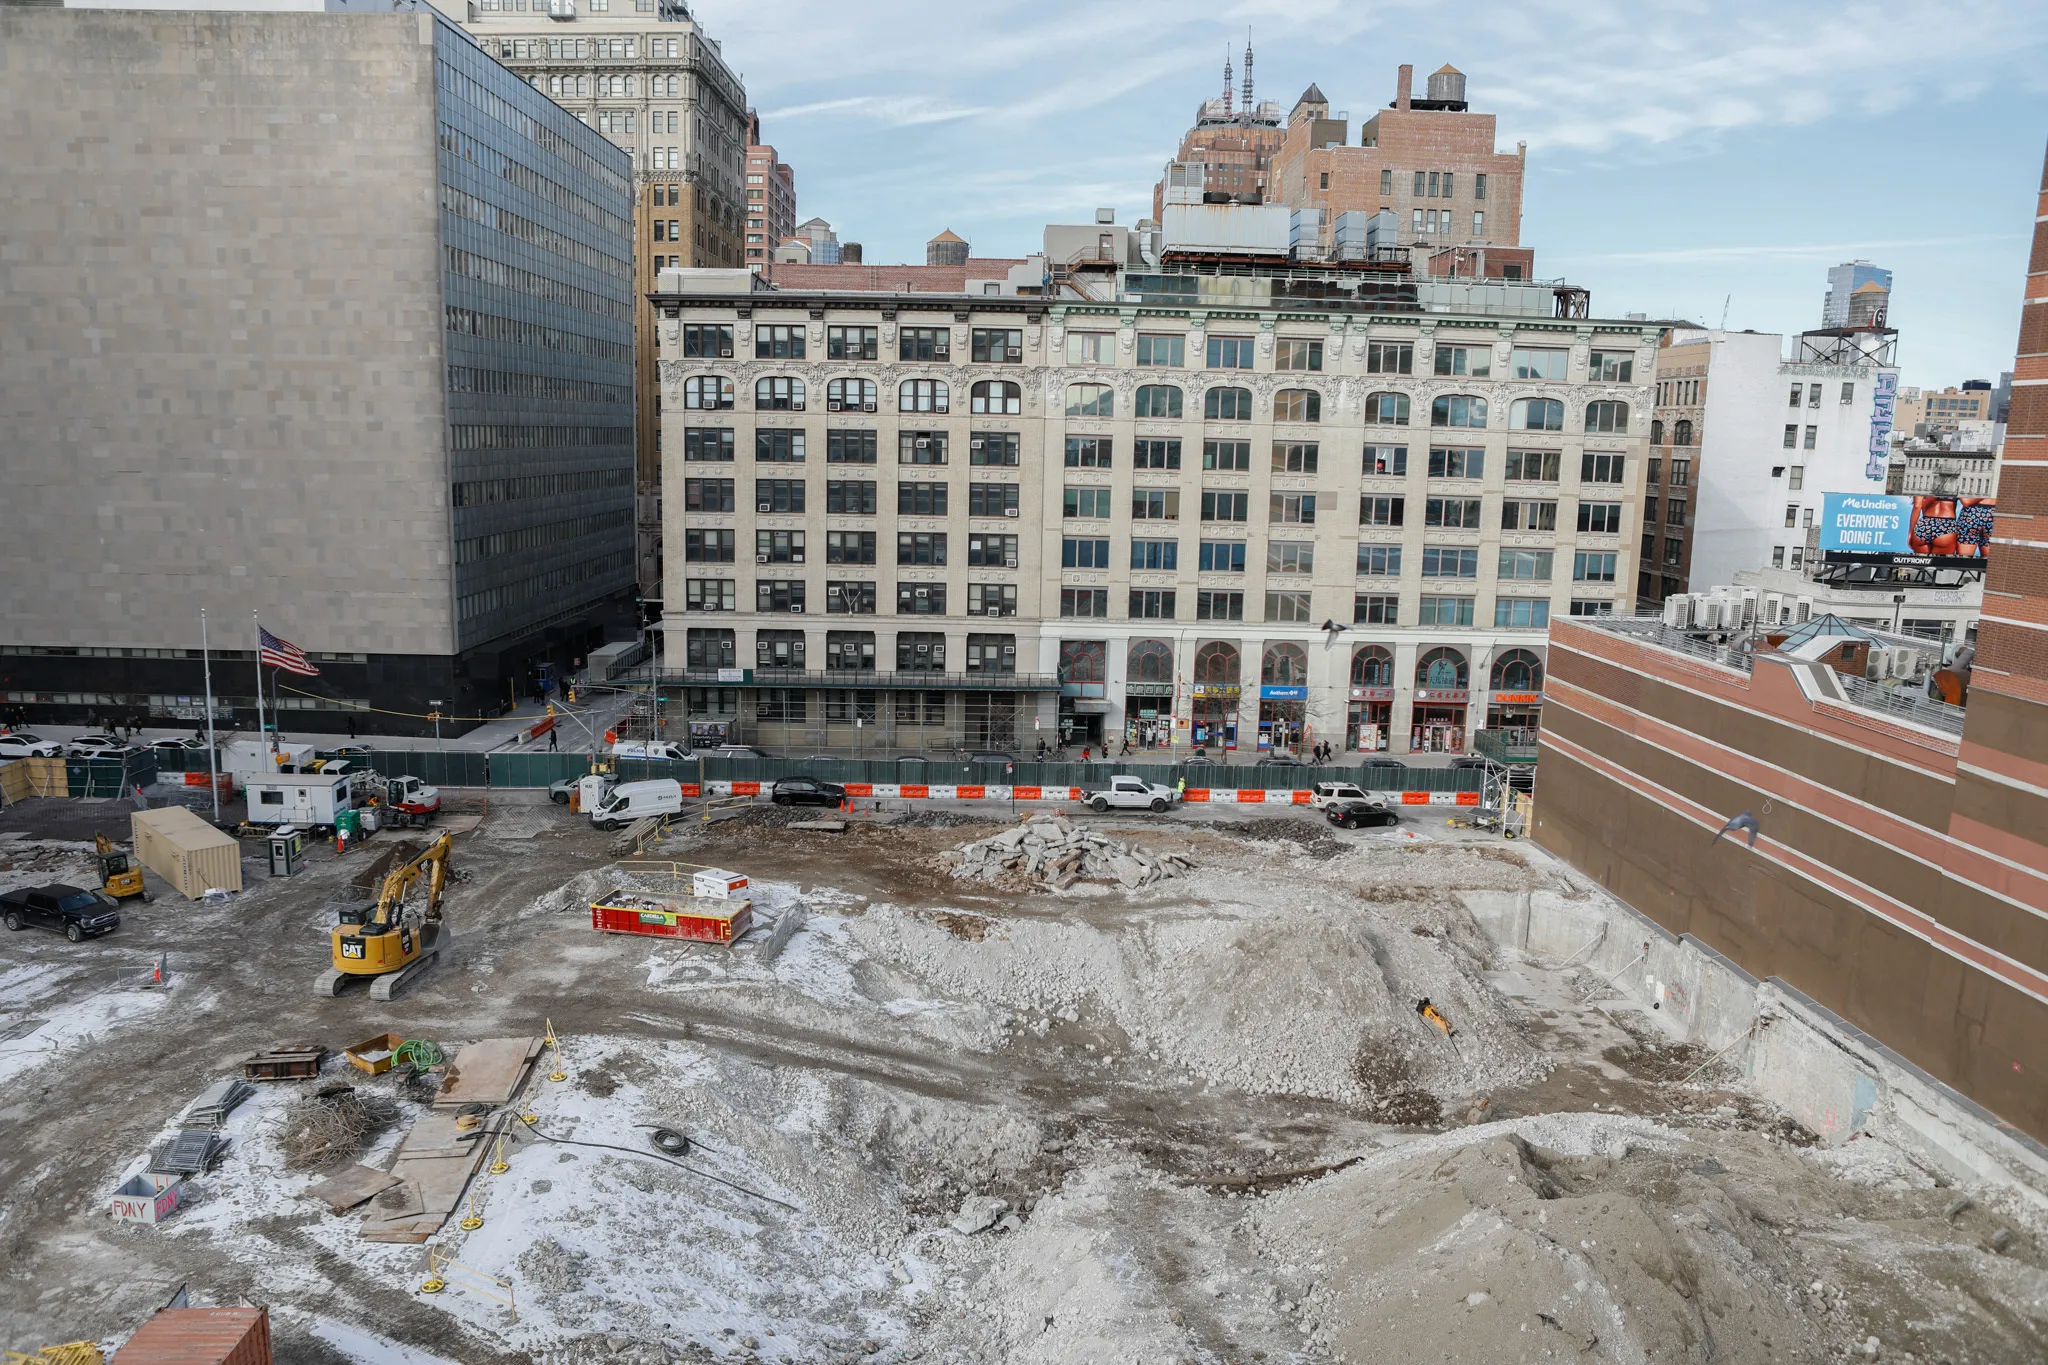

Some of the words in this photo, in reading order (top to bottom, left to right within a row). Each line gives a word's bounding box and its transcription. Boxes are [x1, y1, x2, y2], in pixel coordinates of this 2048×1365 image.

[1842, 497, 1897, 510] MeUndies
[1836, 513, 1899, 530] EVERYONE'S
[1840, 530, 1872, 545] DOING
[1874, 531, 1891, 546] IT...
[1495, 693, 1539, 703] DUNKIN'
[342, 943, 363, 959] CAT
[113, 1199, 147, 1219] FDNY
[155, 1189, 178, 1220] FDNY
